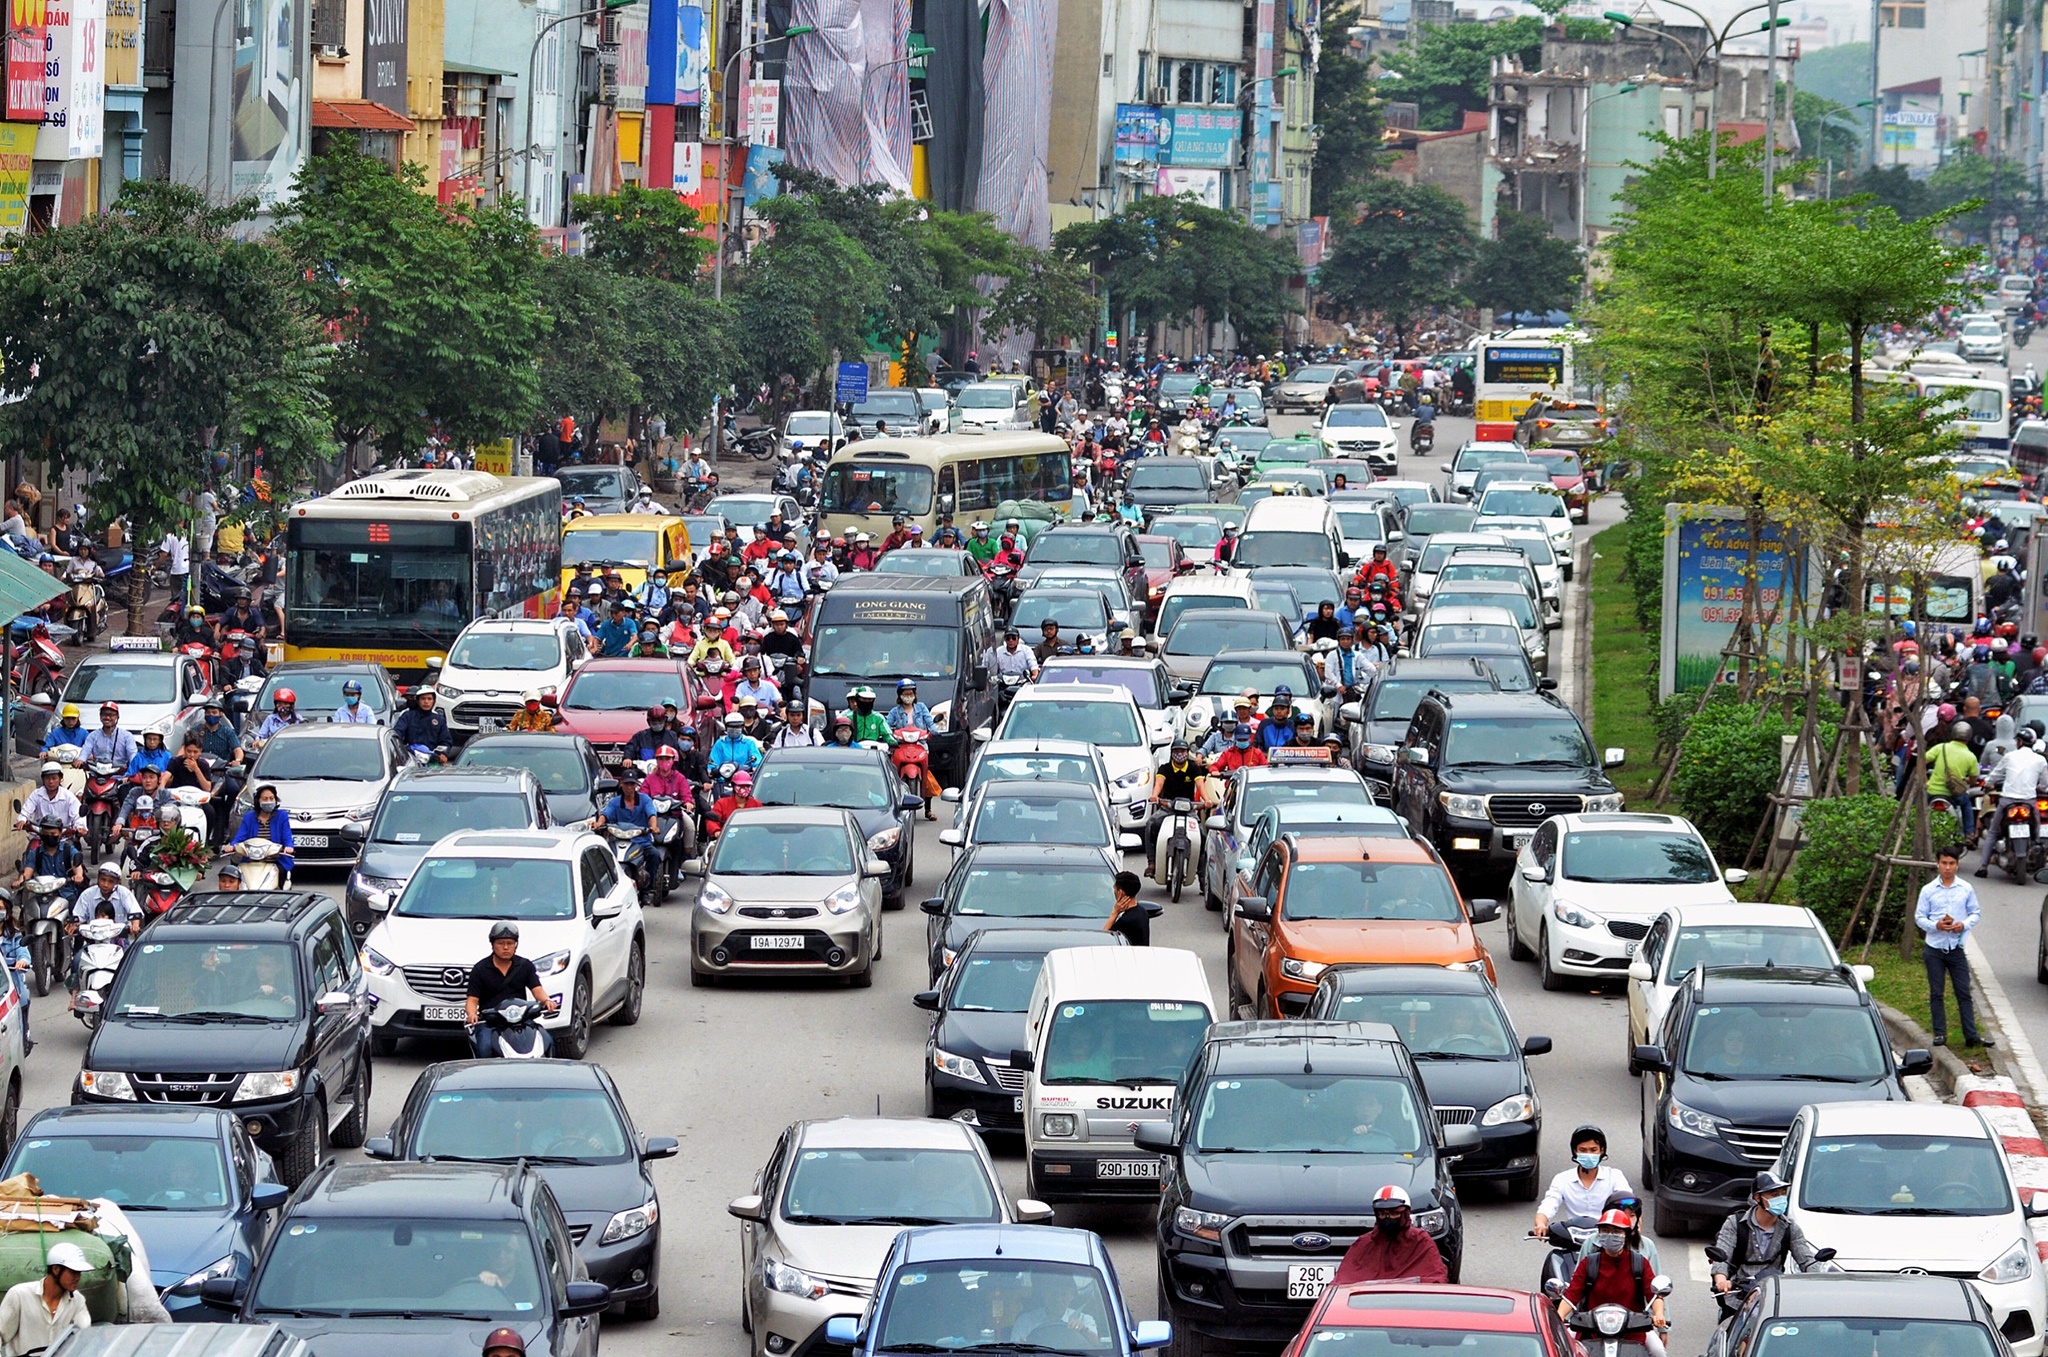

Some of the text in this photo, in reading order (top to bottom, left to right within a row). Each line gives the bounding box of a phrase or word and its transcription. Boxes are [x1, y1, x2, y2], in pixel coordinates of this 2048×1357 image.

[46, 9, 70, 26] OÁN
[82, 19, 96, 73] 18
[46, 57, 60, 77] SỐ
[45, 87, 60, 105] ỌN
[1726, 538, 1783, 554] Adveising
[890, 602, 926, 610] GIANG
[397, 654, 419, 663] LONG
[426, 1007, 466, 1019] 30E-858
[169, 1084, 199, 1092] ISUZU
[1096, 1097, 1172, 1110] SUZUKI
[1301, 1235, 1323, 1246] Ford
[1299, 1267, 1324, 1281] 29C
